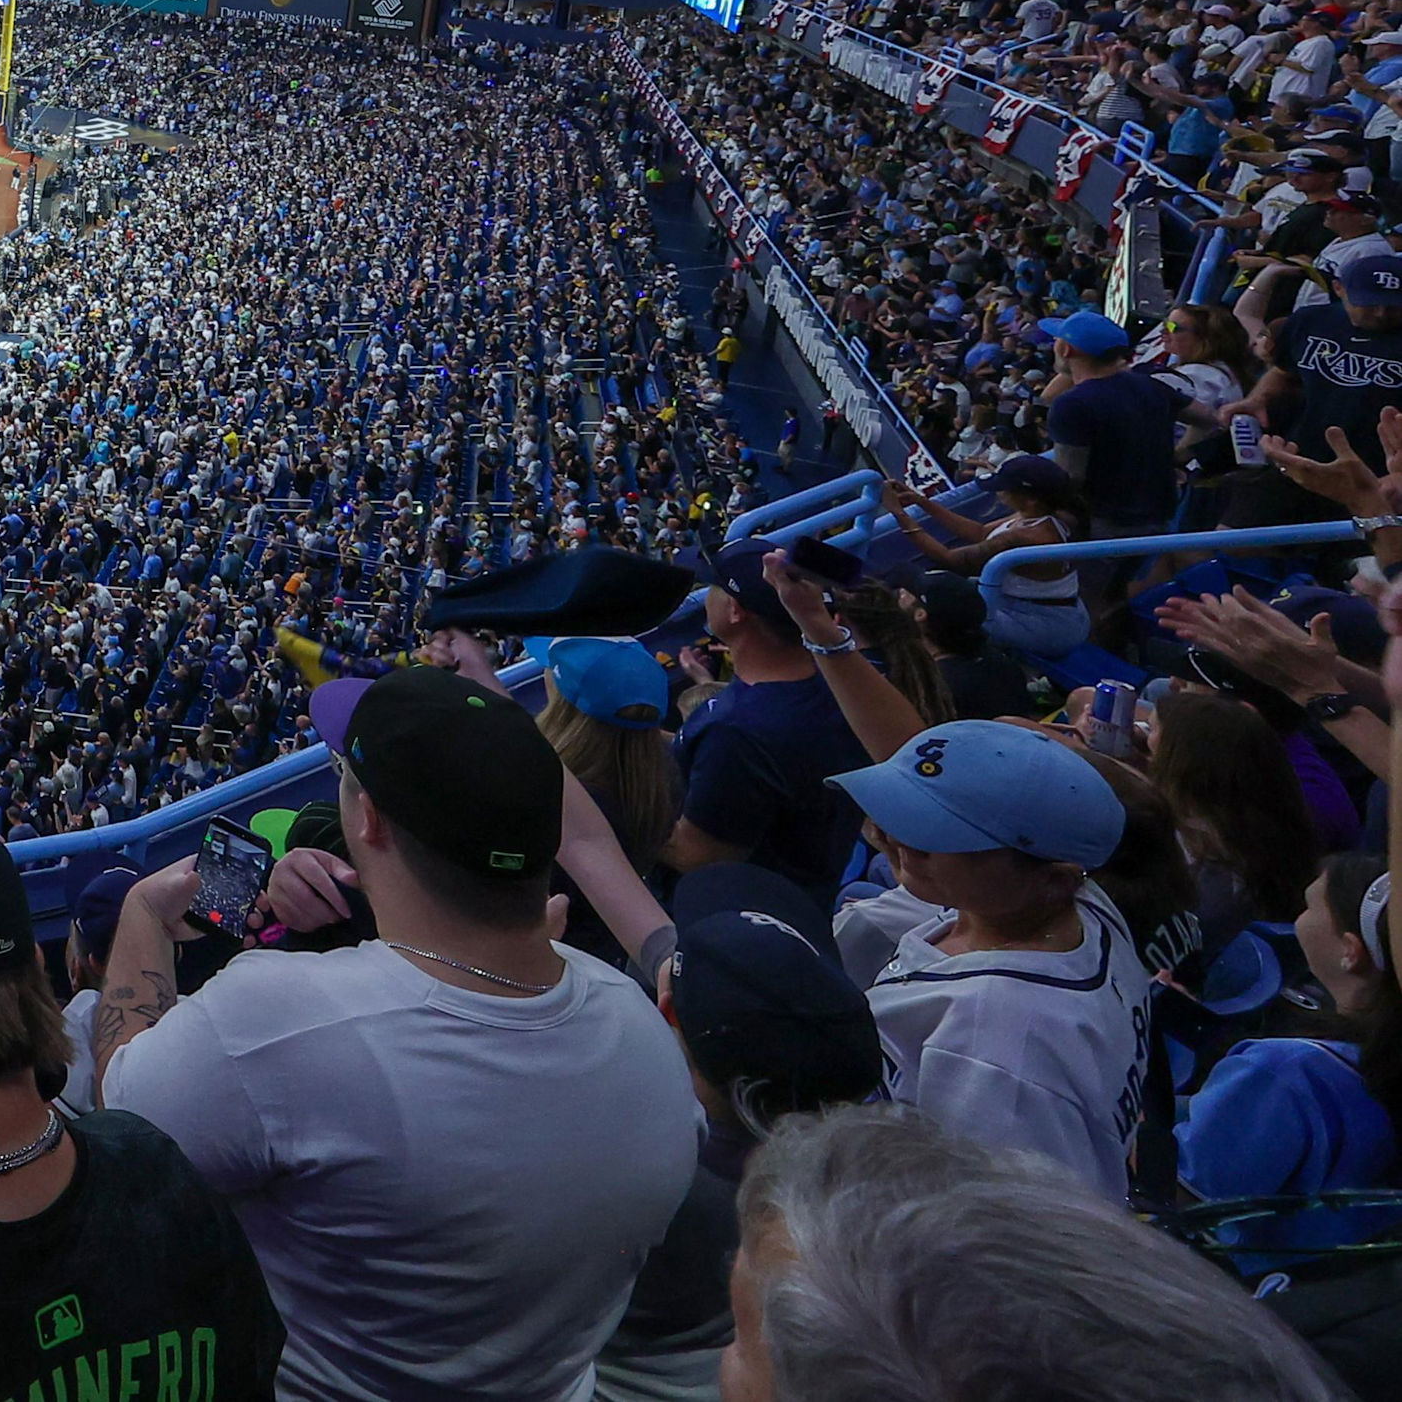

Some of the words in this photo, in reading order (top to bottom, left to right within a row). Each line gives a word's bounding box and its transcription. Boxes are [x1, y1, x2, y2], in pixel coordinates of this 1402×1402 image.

[220, 6, 257, 19] DREAM
[258, 9, 301, 24] FINDERS
[302, 15, 343, 27] HOMES
[1373, 271, 1400, 289] TB
[1298, 335, 1402, 388] RAYS
